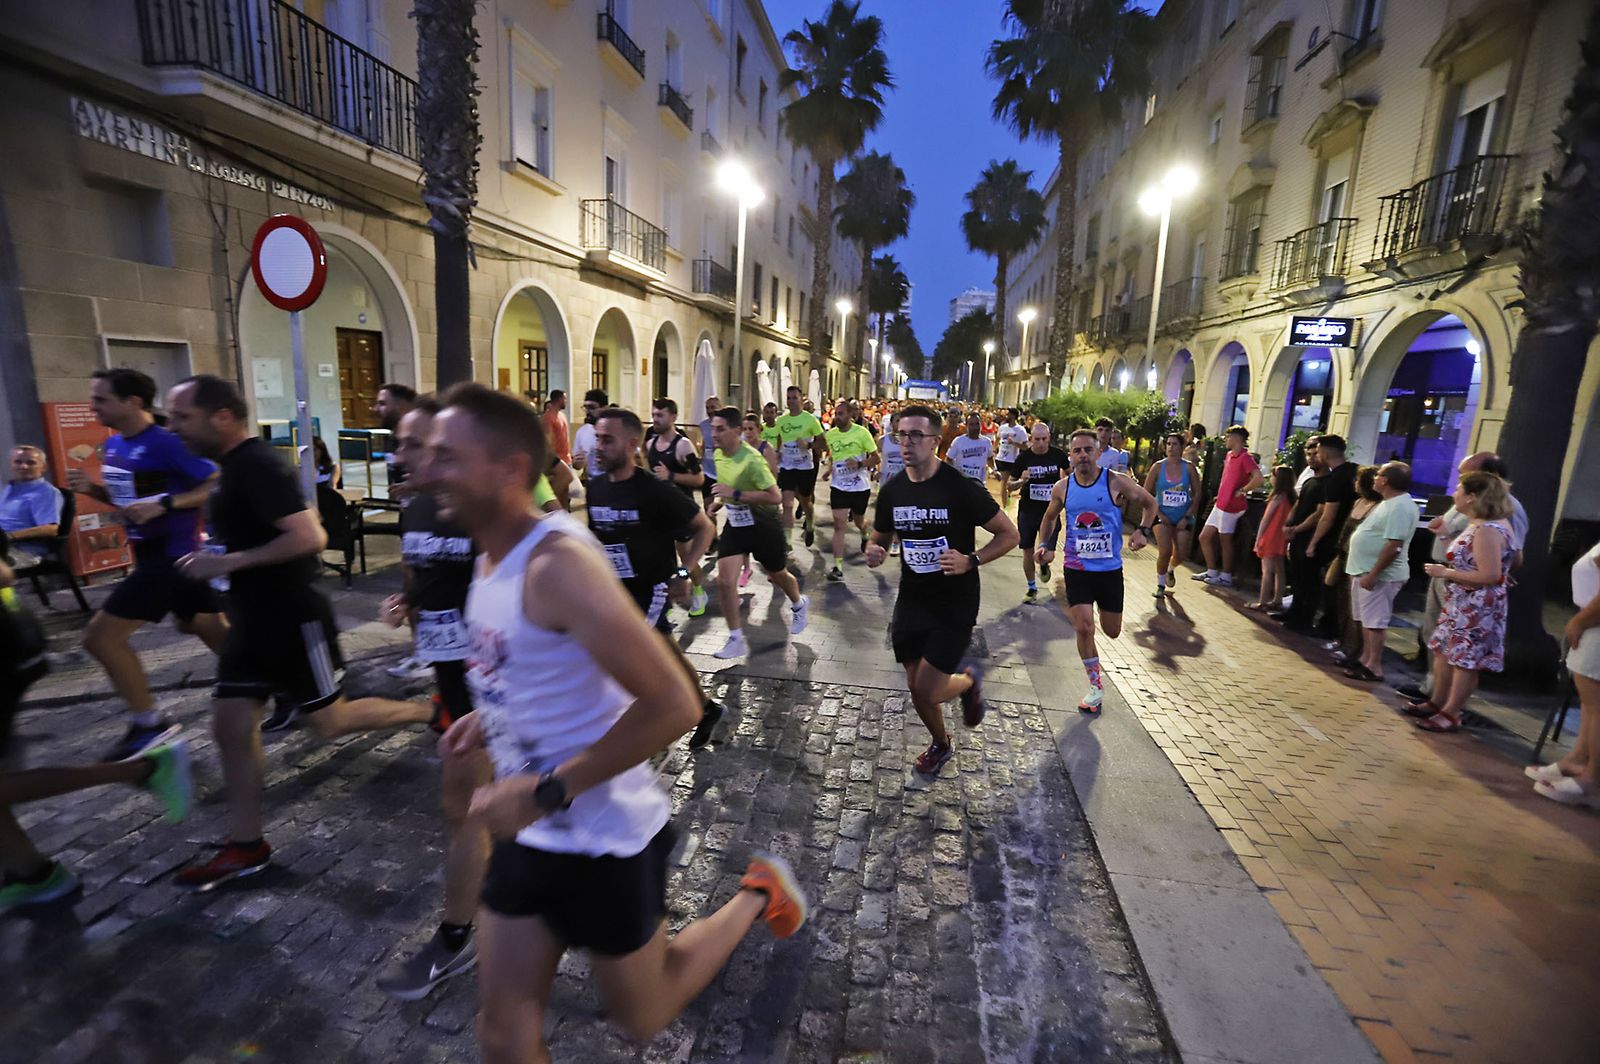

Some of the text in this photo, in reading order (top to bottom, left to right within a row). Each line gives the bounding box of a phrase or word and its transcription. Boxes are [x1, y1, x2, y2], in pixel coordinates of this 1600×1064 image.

[74, 100, 190, 151] AVENIDA
[911, 509, 928, 520] FOR
[929, 508, 948, 520] FUN
[1085, 542, 1102, 552] 824
[915, 551, 935, 564] 392
